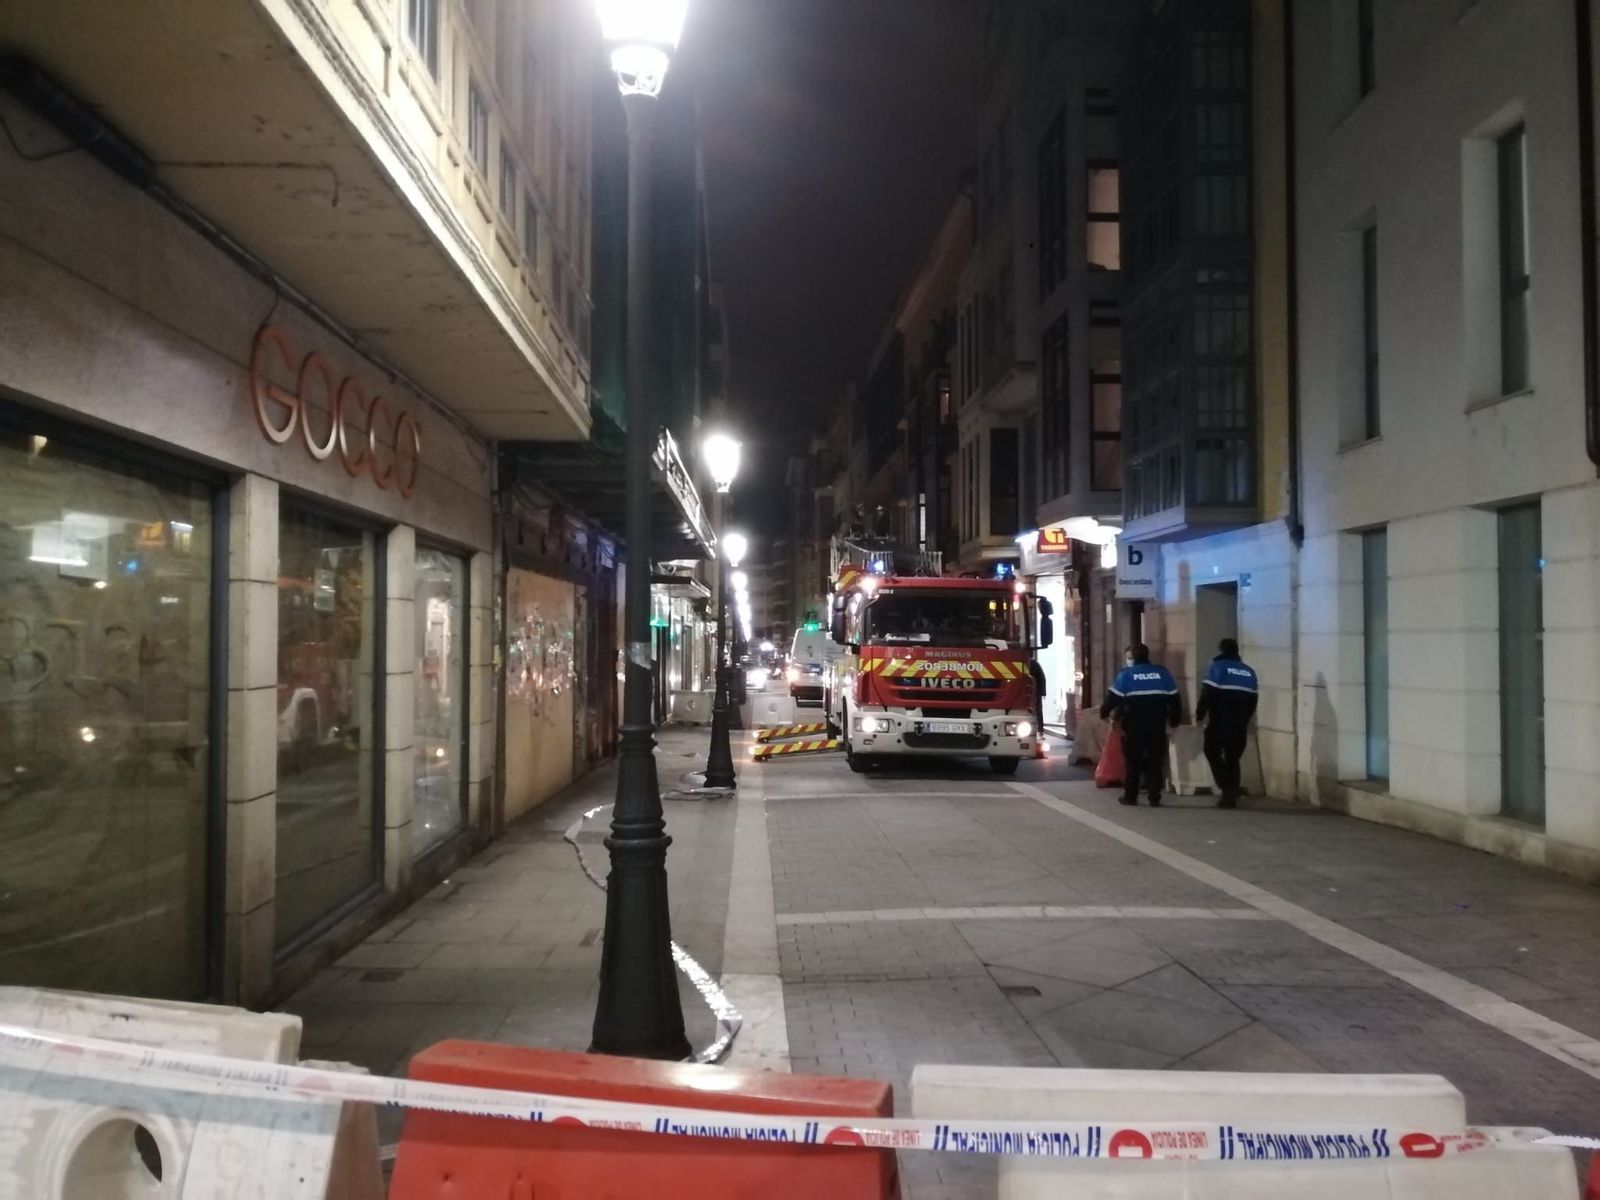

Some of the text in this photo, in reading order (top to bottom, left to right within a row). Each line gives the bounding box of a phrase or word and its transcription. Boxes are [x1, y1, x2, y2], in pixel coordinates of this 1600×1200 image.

[249, 323, 421, 498] GOCCO
[1128, 545, 1143, 565] b
[925, 650, 972, 658] MAGIRUS
[920, 677, 976, 689] IVECO
